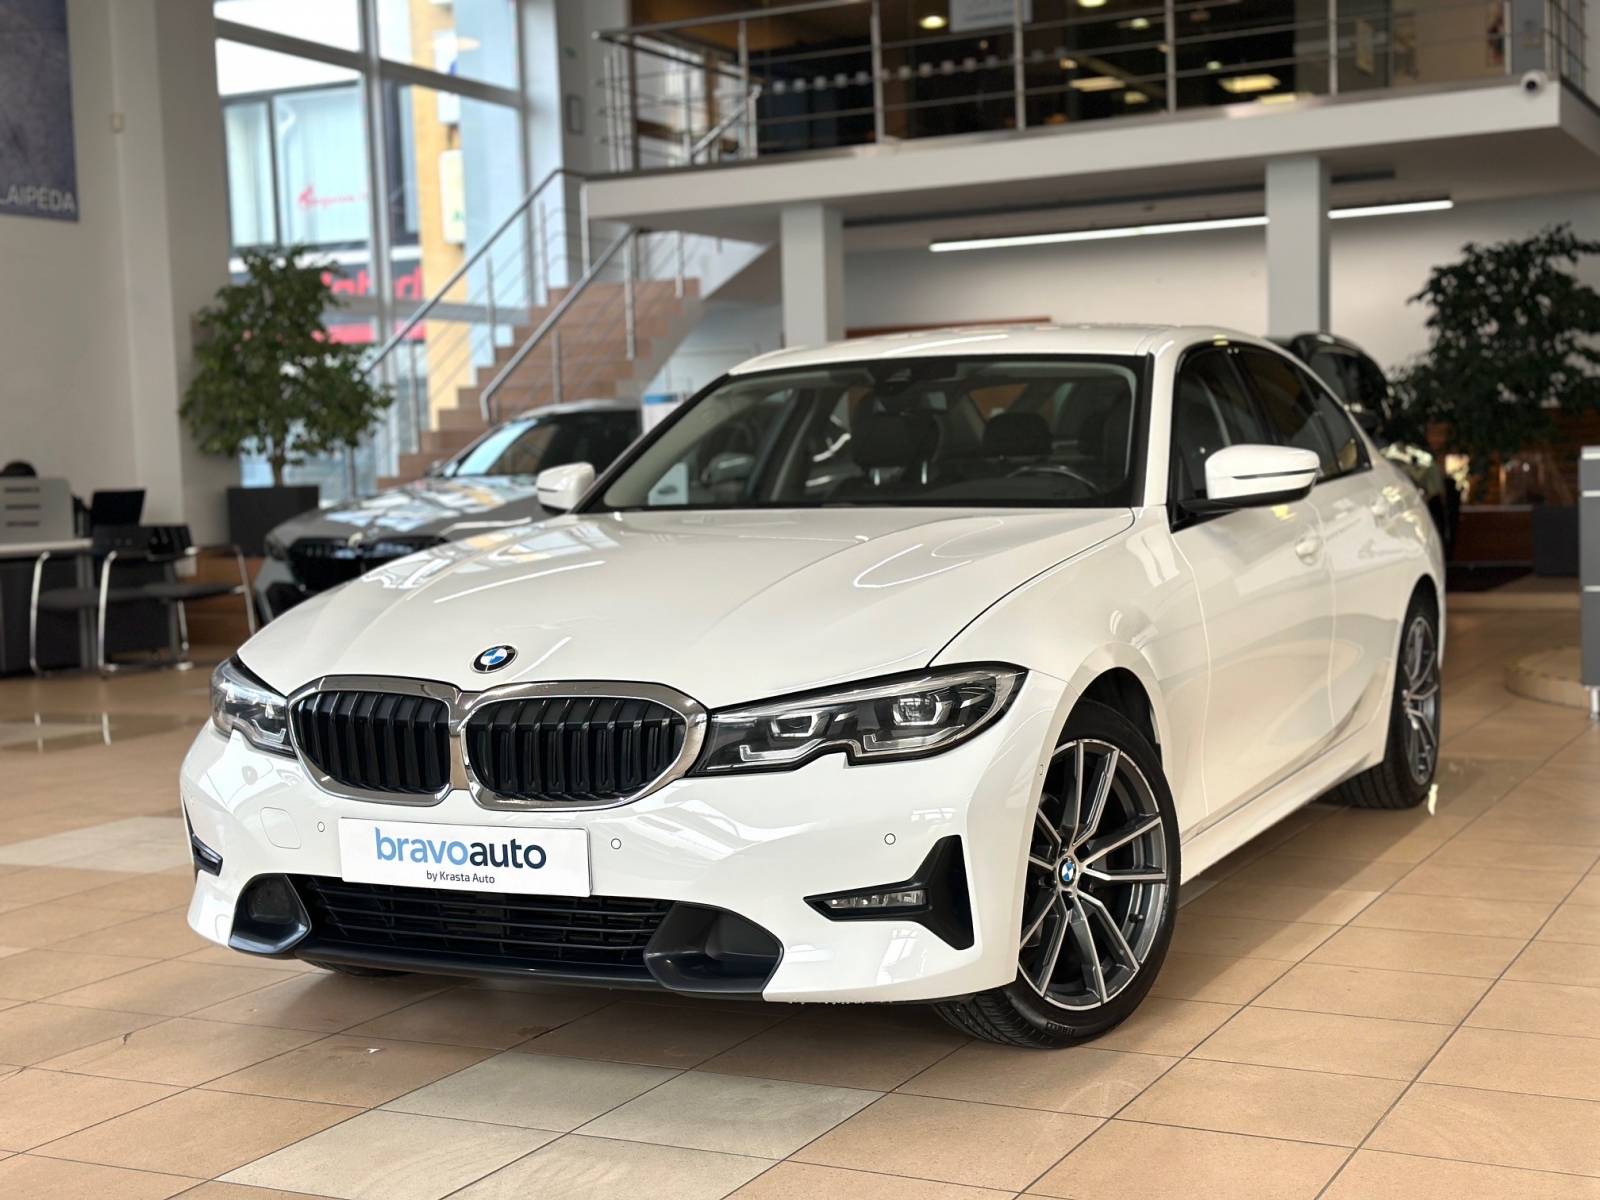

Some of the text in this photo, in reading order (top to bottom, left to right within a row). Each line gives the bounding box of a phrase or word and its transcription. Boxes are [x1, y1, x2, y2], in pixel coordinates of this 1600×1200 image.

[375, 826, 547, 870] bravoauto
[426, 870, 496, 884] by Krasta Auto
